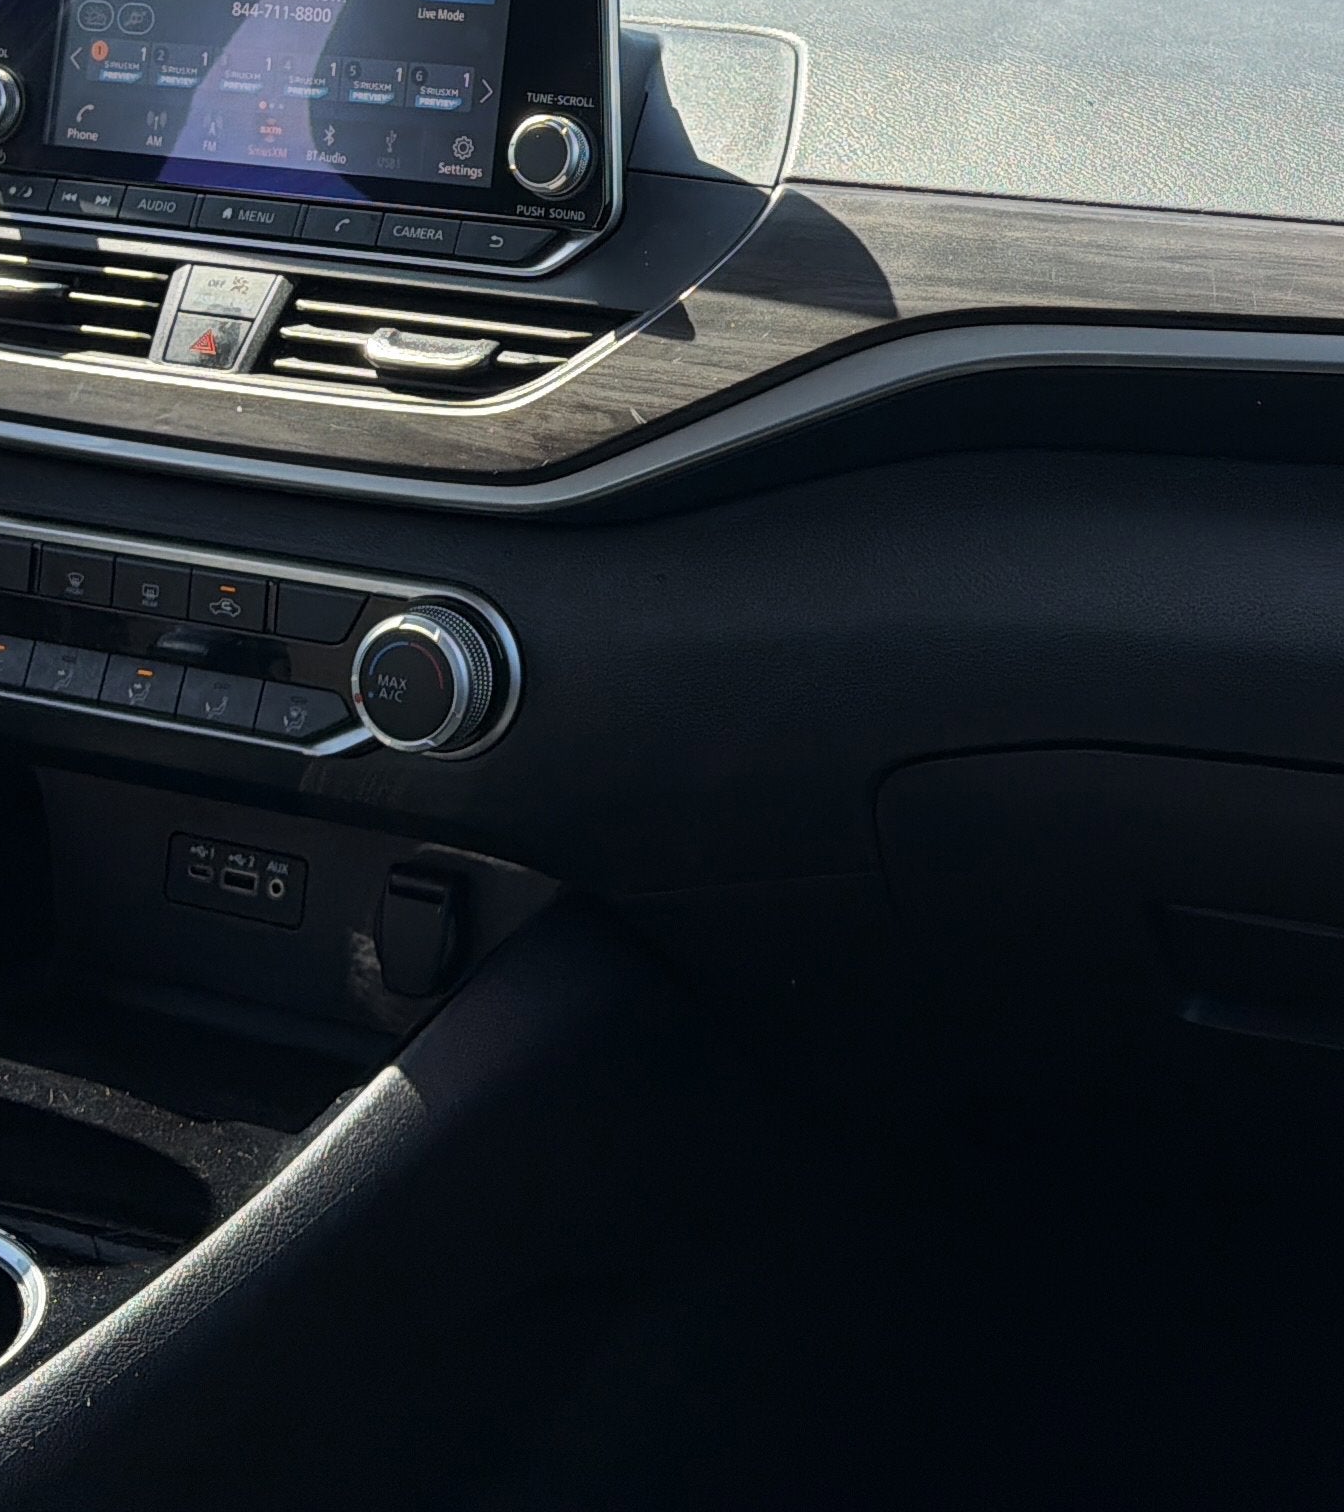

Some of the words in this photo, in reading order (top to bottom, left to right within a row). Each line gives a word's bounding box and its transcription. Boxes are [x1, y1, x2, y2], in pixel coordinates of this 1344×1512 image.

[231, 2, 332, 23] 844-711-8800
[417, 7, 436, 20] Live
[437, 8, 465, 22] Mode
[140, 46, 147, 61] 1
[201, 51, 208, 66] 1
[265, 57, 272, 71] 1
[330, 62, 337, 77] 1
[349, 65, 357, 76] 5
[395, 67, 403, 82] 1
[416, 70, 424, 81] 6
[463, 72, 470, 88] 1
[67, 127, 99, 142] Phone
[146, 135, 163, 147] AM
[203, 140, 217, 152] FM
[306, 150, 318, 162] BT
[318, 151, 347, 165] Audio
[438, 161, 483, 180] Settings
[138, 197, 177, 213] AUDIO
[237, 208, 276, 224] MENU
[516, 204, 545, 218] PUSH
[549, 208, 586, 222] SOUND
[393, 225, 444, 241] CAMERA
[378, 673, 407, 691] MAX
[378, 687, 404, 703] A/C
[266, 860, 289, 877] AUX
